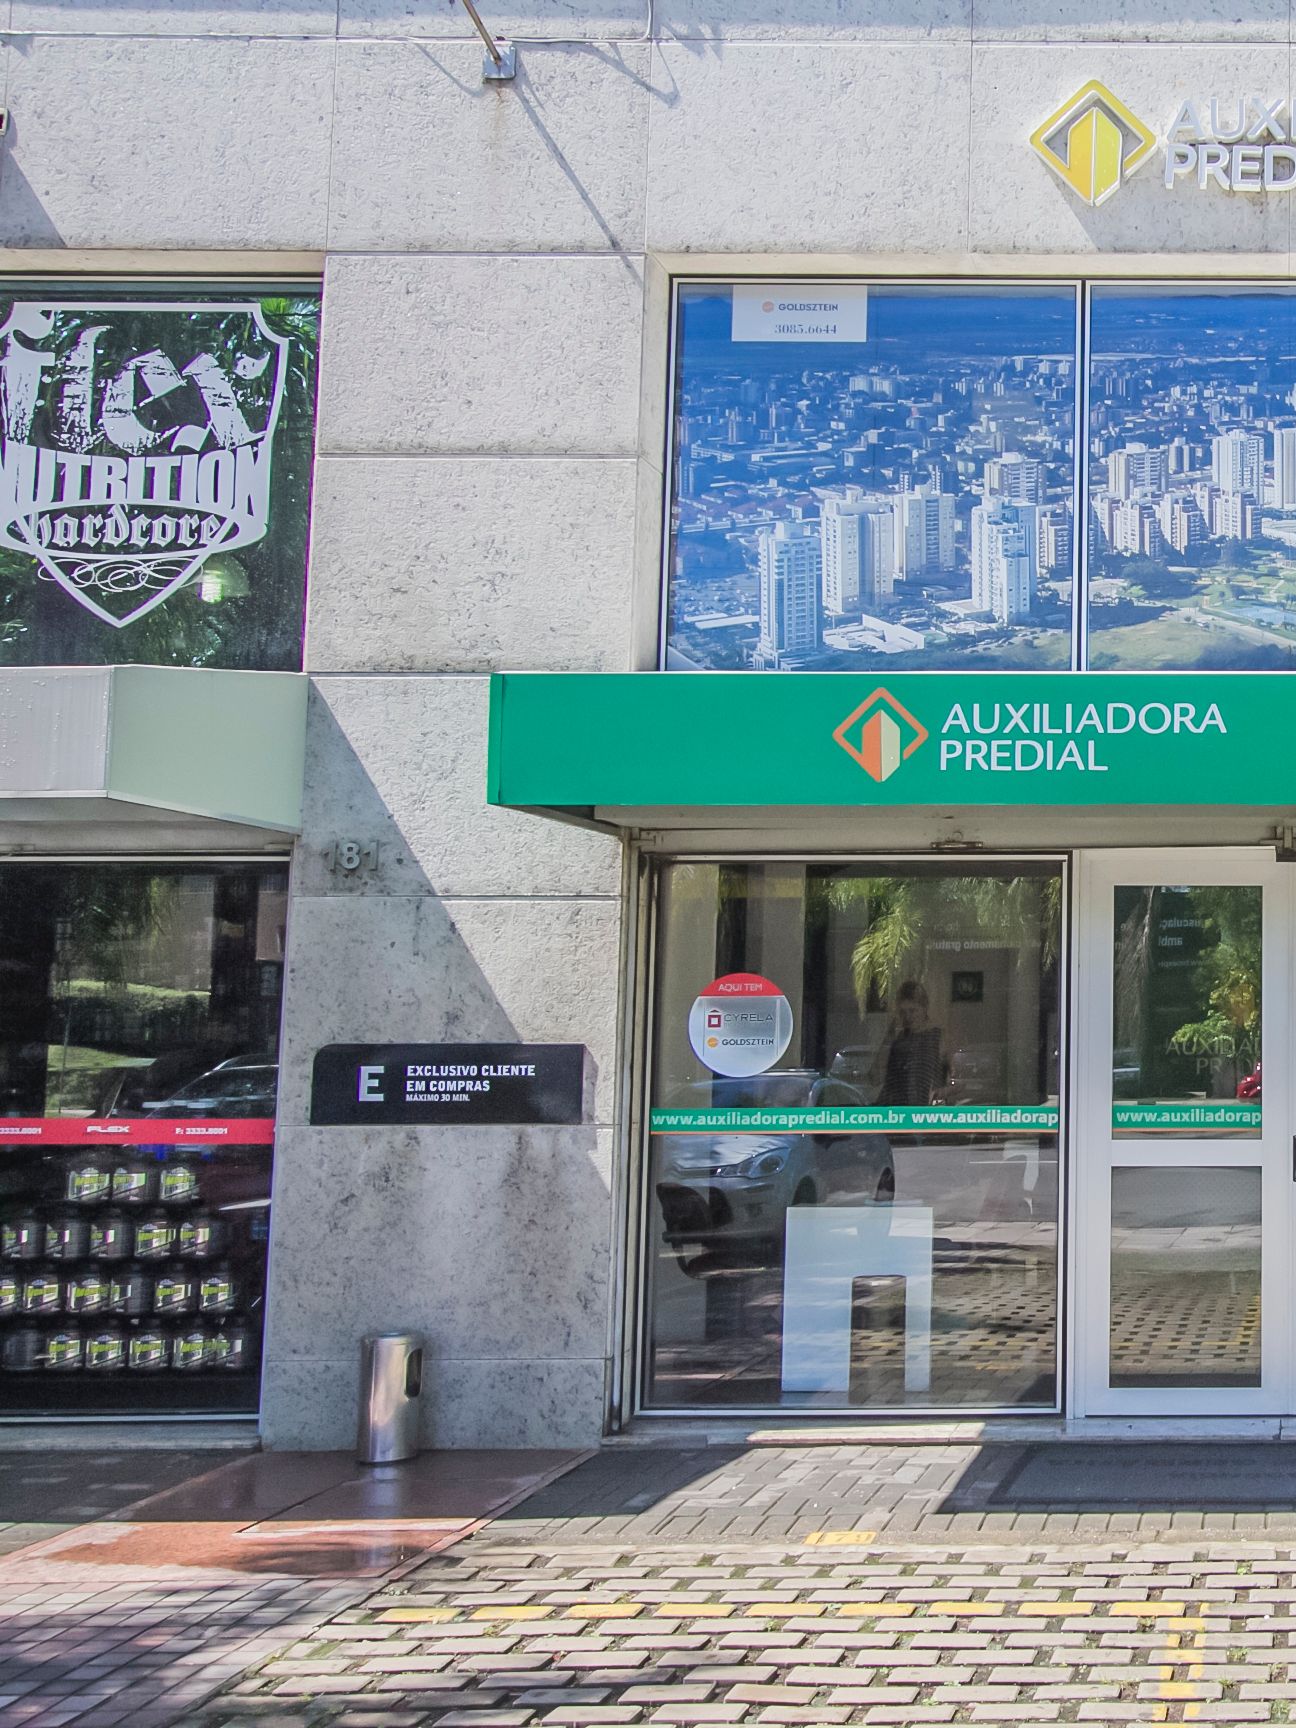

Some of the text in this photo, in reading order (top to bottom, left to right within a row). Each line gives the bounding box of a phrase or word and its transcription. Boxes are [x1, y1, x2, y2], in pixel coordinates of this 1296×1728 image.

[778, 303, 839, 312] GOLDSZTEIN
[774, 324, 837, 335] 3085.6644
[24, 503, 226, 549] hardcore
[941, 703, 1228, 734] AUXILIADORA
[940, 739, 1108, 771] PREDIAL
[323, 839, 379, 871] 181
[718, 983, 763, 992] AQUI TEM
[723, 1013, 774, 1022] CYRELA
[722, 1038, 774, 1046] GOLDSZTEIN
[406, 1065, 536, 1077] EXCLUSIVO CLIENTE
[358, 1065, 385, 1102] E
[406, 1080, 491, 1092] EM COMPRAS
[406, 1093, 440, 1102] MÁXIMO
[452, 1094, 470, 1102] MIN.
[652, 1109, 1058, 1127] www.auxiliadorapredial.com.br www.auxiliadorap
[1116, 1108, 1262, 1125] www.auxiliadorap
[86, 1125, 130, 1133] FLEX
